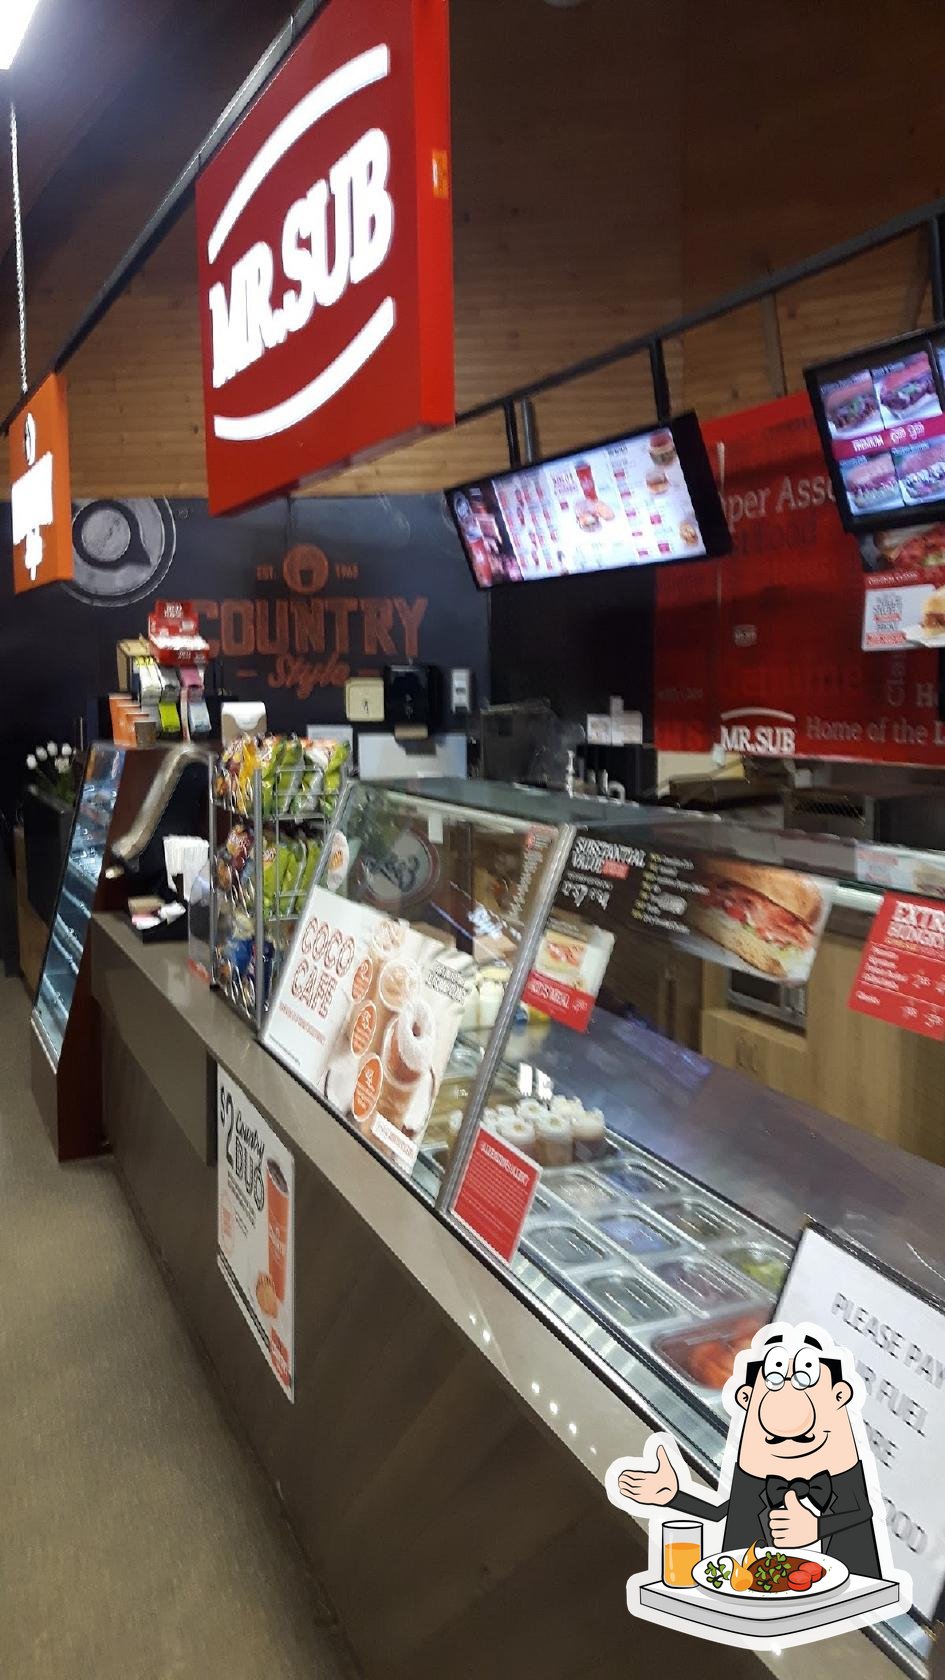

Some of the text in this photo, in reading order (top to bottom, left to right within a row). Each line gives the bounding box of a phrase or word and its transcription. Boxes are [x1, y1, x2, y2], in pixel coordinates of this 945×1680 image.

[209, 128, 394, 388] MR.SUB
[191, 597, 428, 656] COUNTRY
[267, 651, 350, 699] Style
[720, 724, 797, 755] MR.SUB
[804, 715, 857, 742] Home
[866, 718, 888, 743] of
[893, 716, 929, 746] the
[301, 916, 356, 978] COCO
[235, 1134, 265, 1212] DUO
[831, 1291, 906, 1361] PLEASE
[876, 1375, 928, 1440] FUEL
